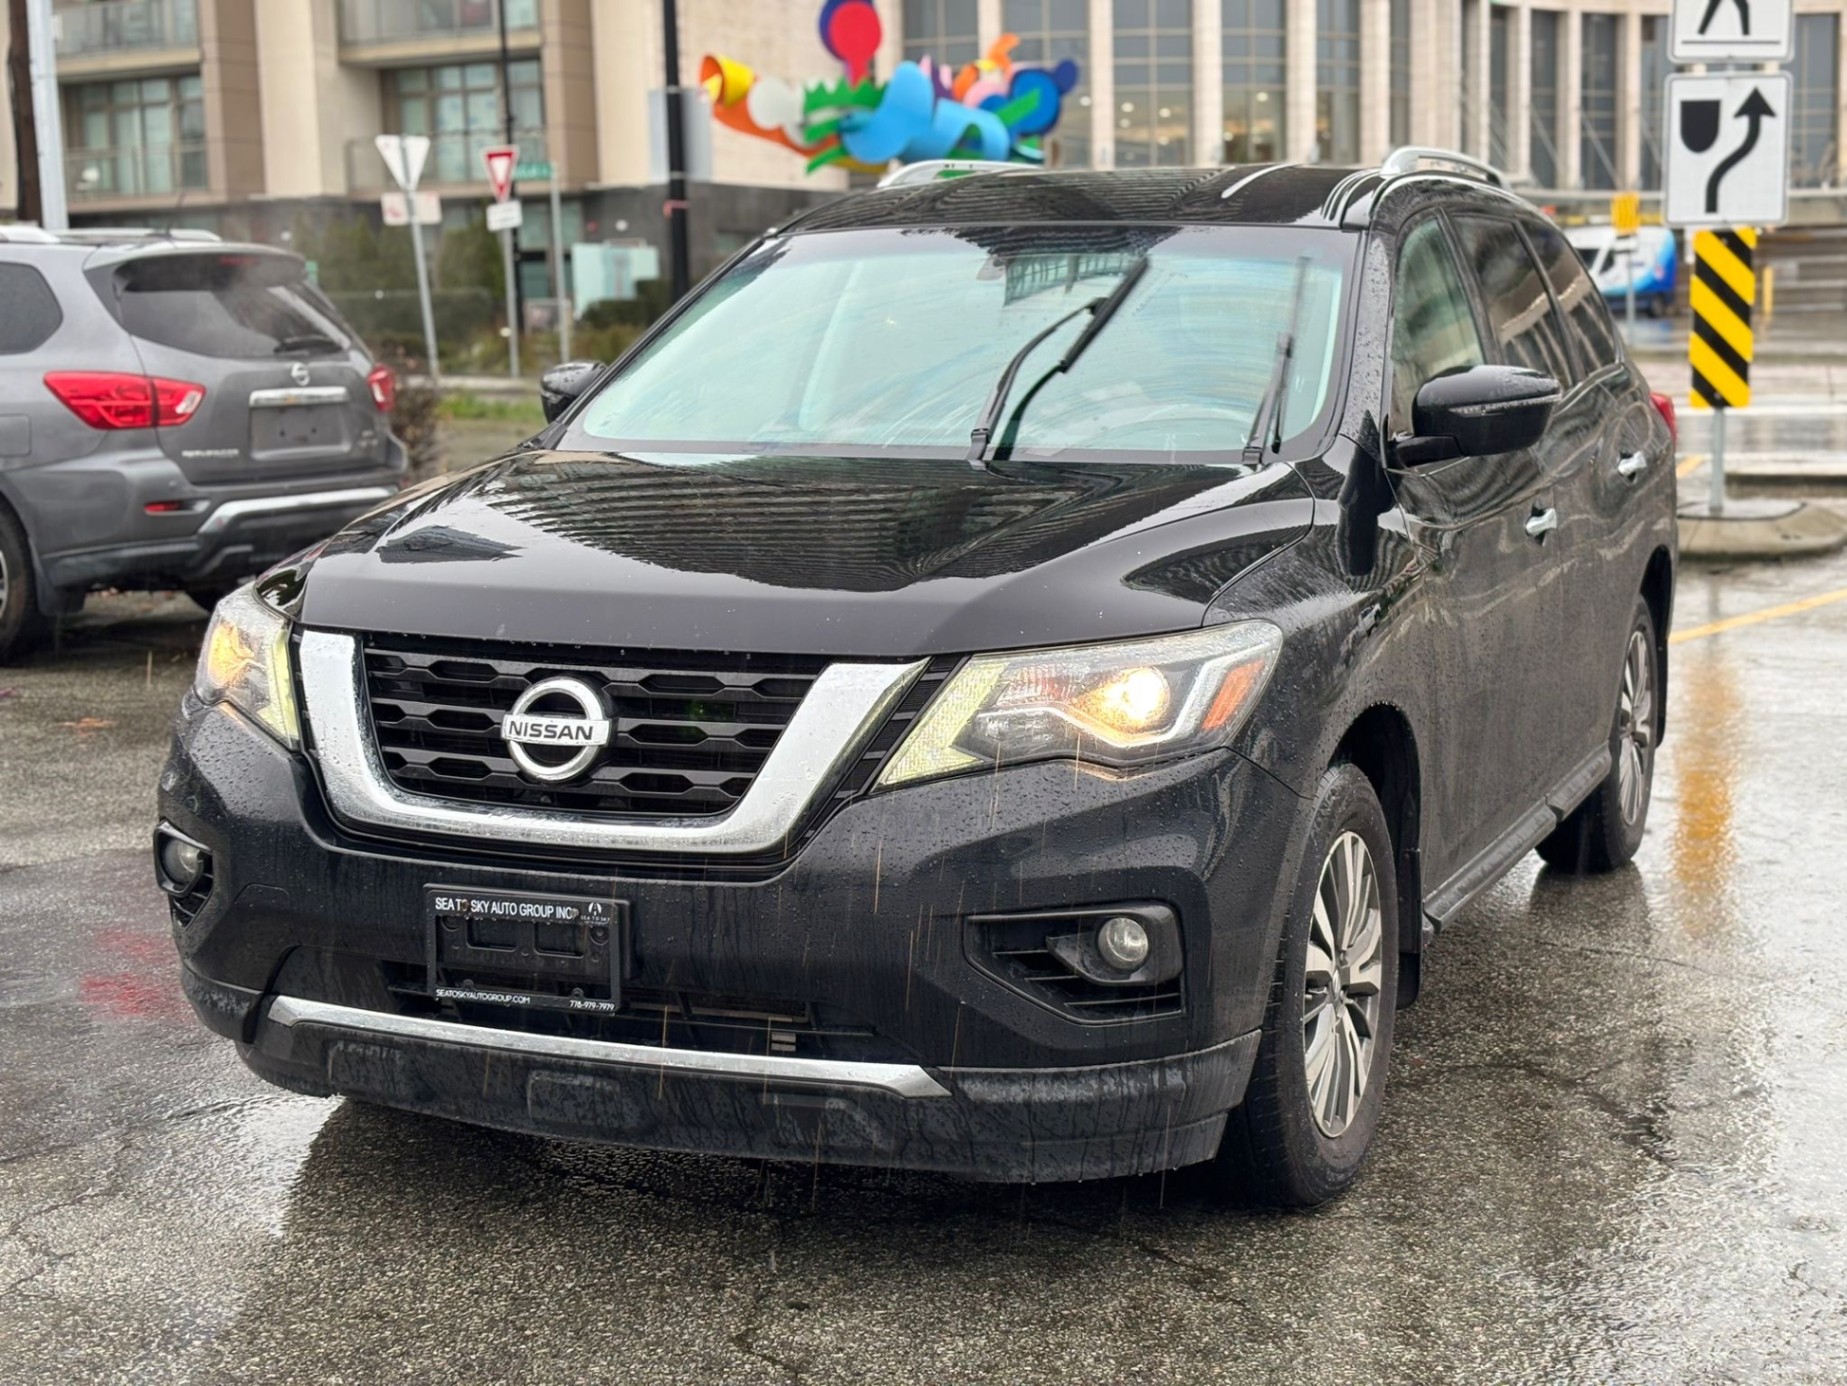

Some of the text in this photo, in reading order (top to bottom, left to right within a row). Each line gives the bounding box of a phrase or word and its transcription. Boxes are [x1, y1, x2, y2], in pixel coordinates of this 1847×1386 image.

[509, 720, 593, 740] NISSAN
[435, 897, 455, 911] SEA
[470, 899, 490, 914] SKY
[490, 901, 517, 915] AUTO
[519, 903, 554, 918] GROUP
[435, 988, 531, 1004] SEATOSKYAUTOGROUP.COM
